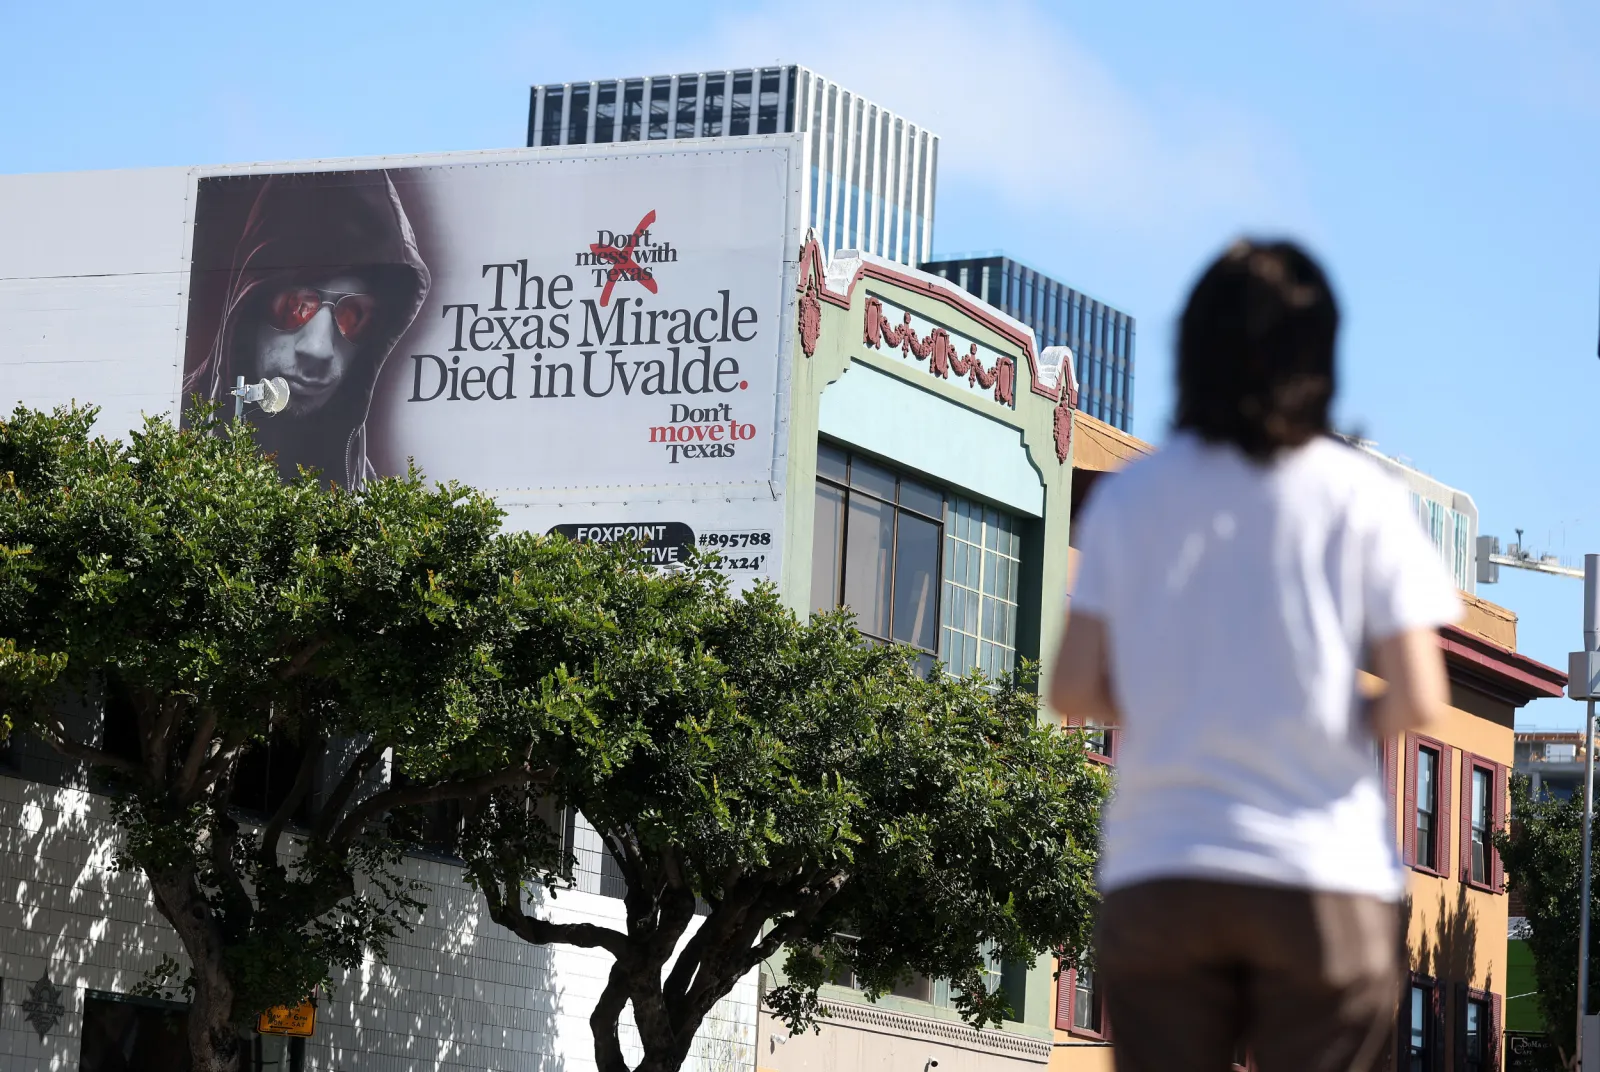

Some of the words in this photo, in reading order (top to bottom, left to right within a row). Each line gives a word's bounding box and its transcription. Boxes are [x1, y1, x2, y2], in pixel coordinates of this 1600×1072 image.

[597, 229, 652, 249] Don't
[575, 250, 628, 266] mess
[634, 242, 678, 264] with
[482, 259, 573, 312] The
[591, 266, 653, 288] Texas
[442, 303, 570, 352] Texas
[577, 290, 758, 347] Miracle
[407, 353, 517, 403] Died
[530, 352, 576, 398] in
[580, 346, 748, 398] Uvalde.
[669, 402, 732, 424] Don't
[649, 421, 724, 442] move
[730, 419, 756, 441] to
[666, 442, 735, 464] Texas
[577, 526, 666, 543] FOXPOINT
[699, 533, 771, 548] #895788
